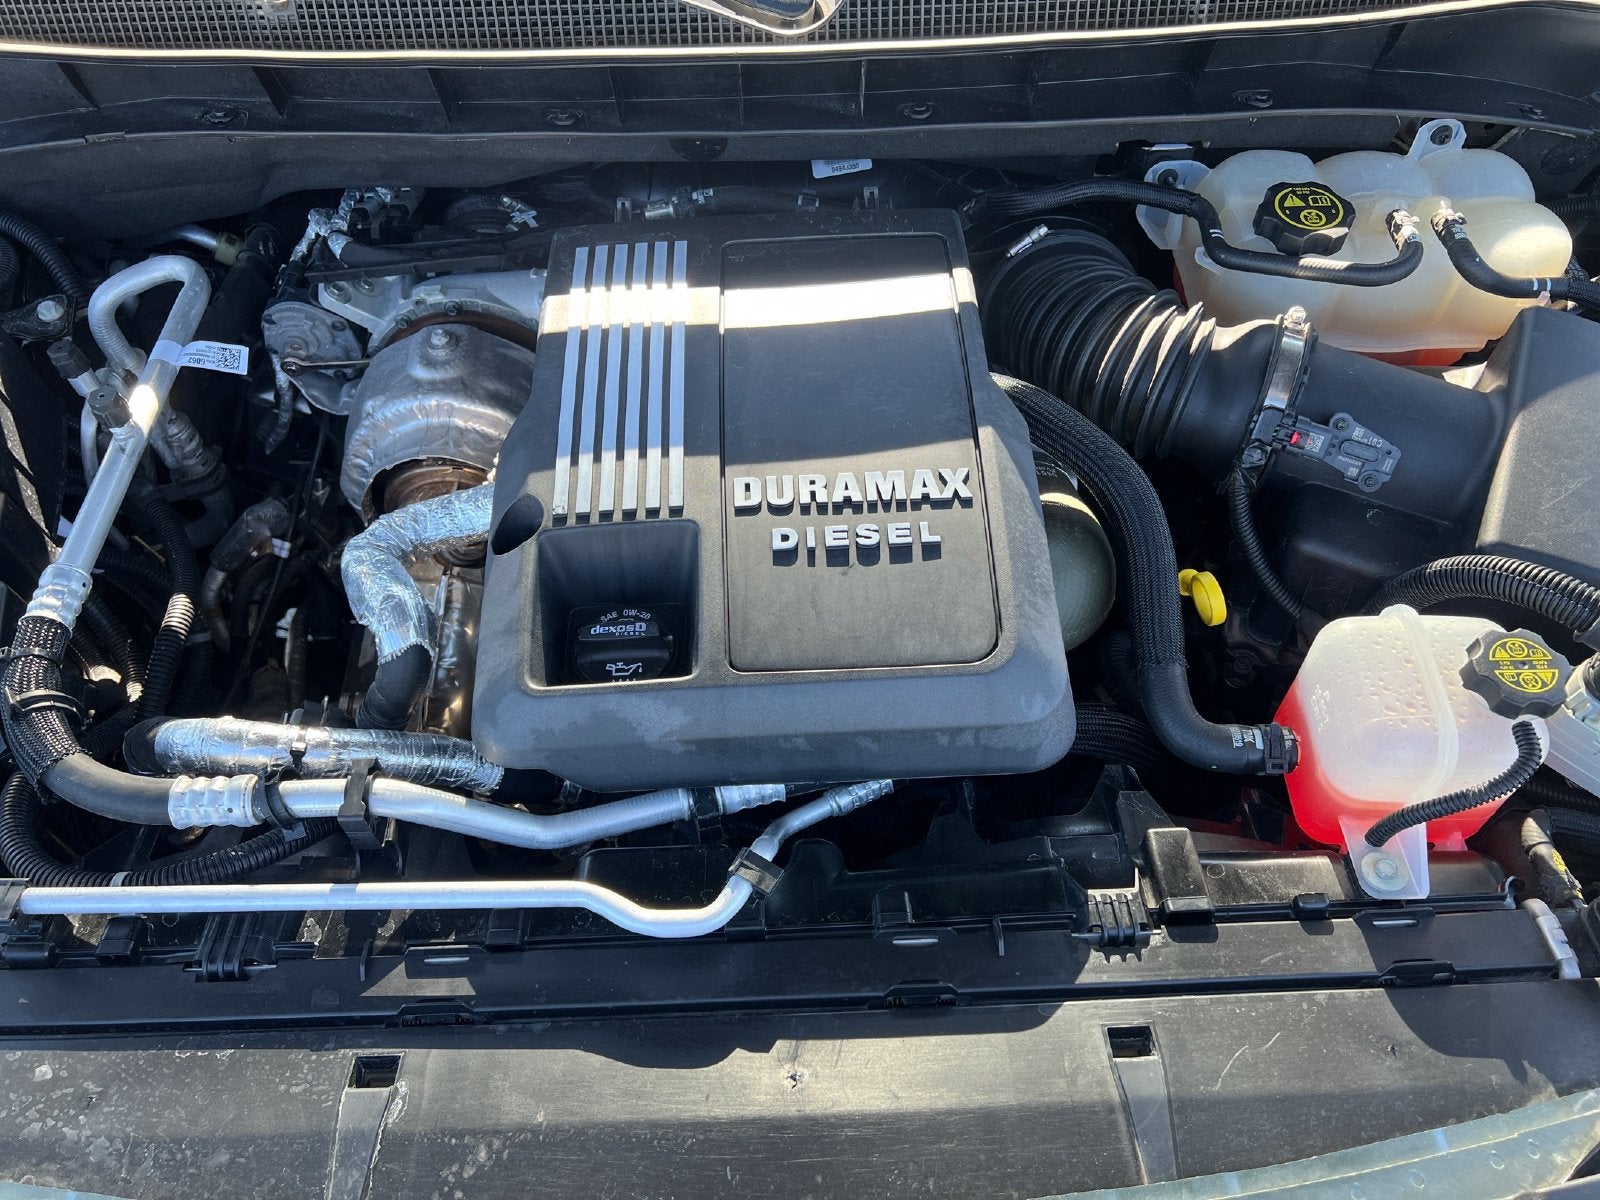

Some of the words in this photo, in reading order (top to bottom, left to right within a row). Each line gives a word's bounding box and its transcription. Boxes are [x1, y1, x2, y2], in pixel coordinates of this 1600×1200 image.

[187, 357, 206, 366] 6062
[733, 468, 974, 509] DURAMAX
[771, 521, 942, 552] DIESEL
[600, 611, 619, 623] SAE
[622, 609, 652, 620] 0W-20
